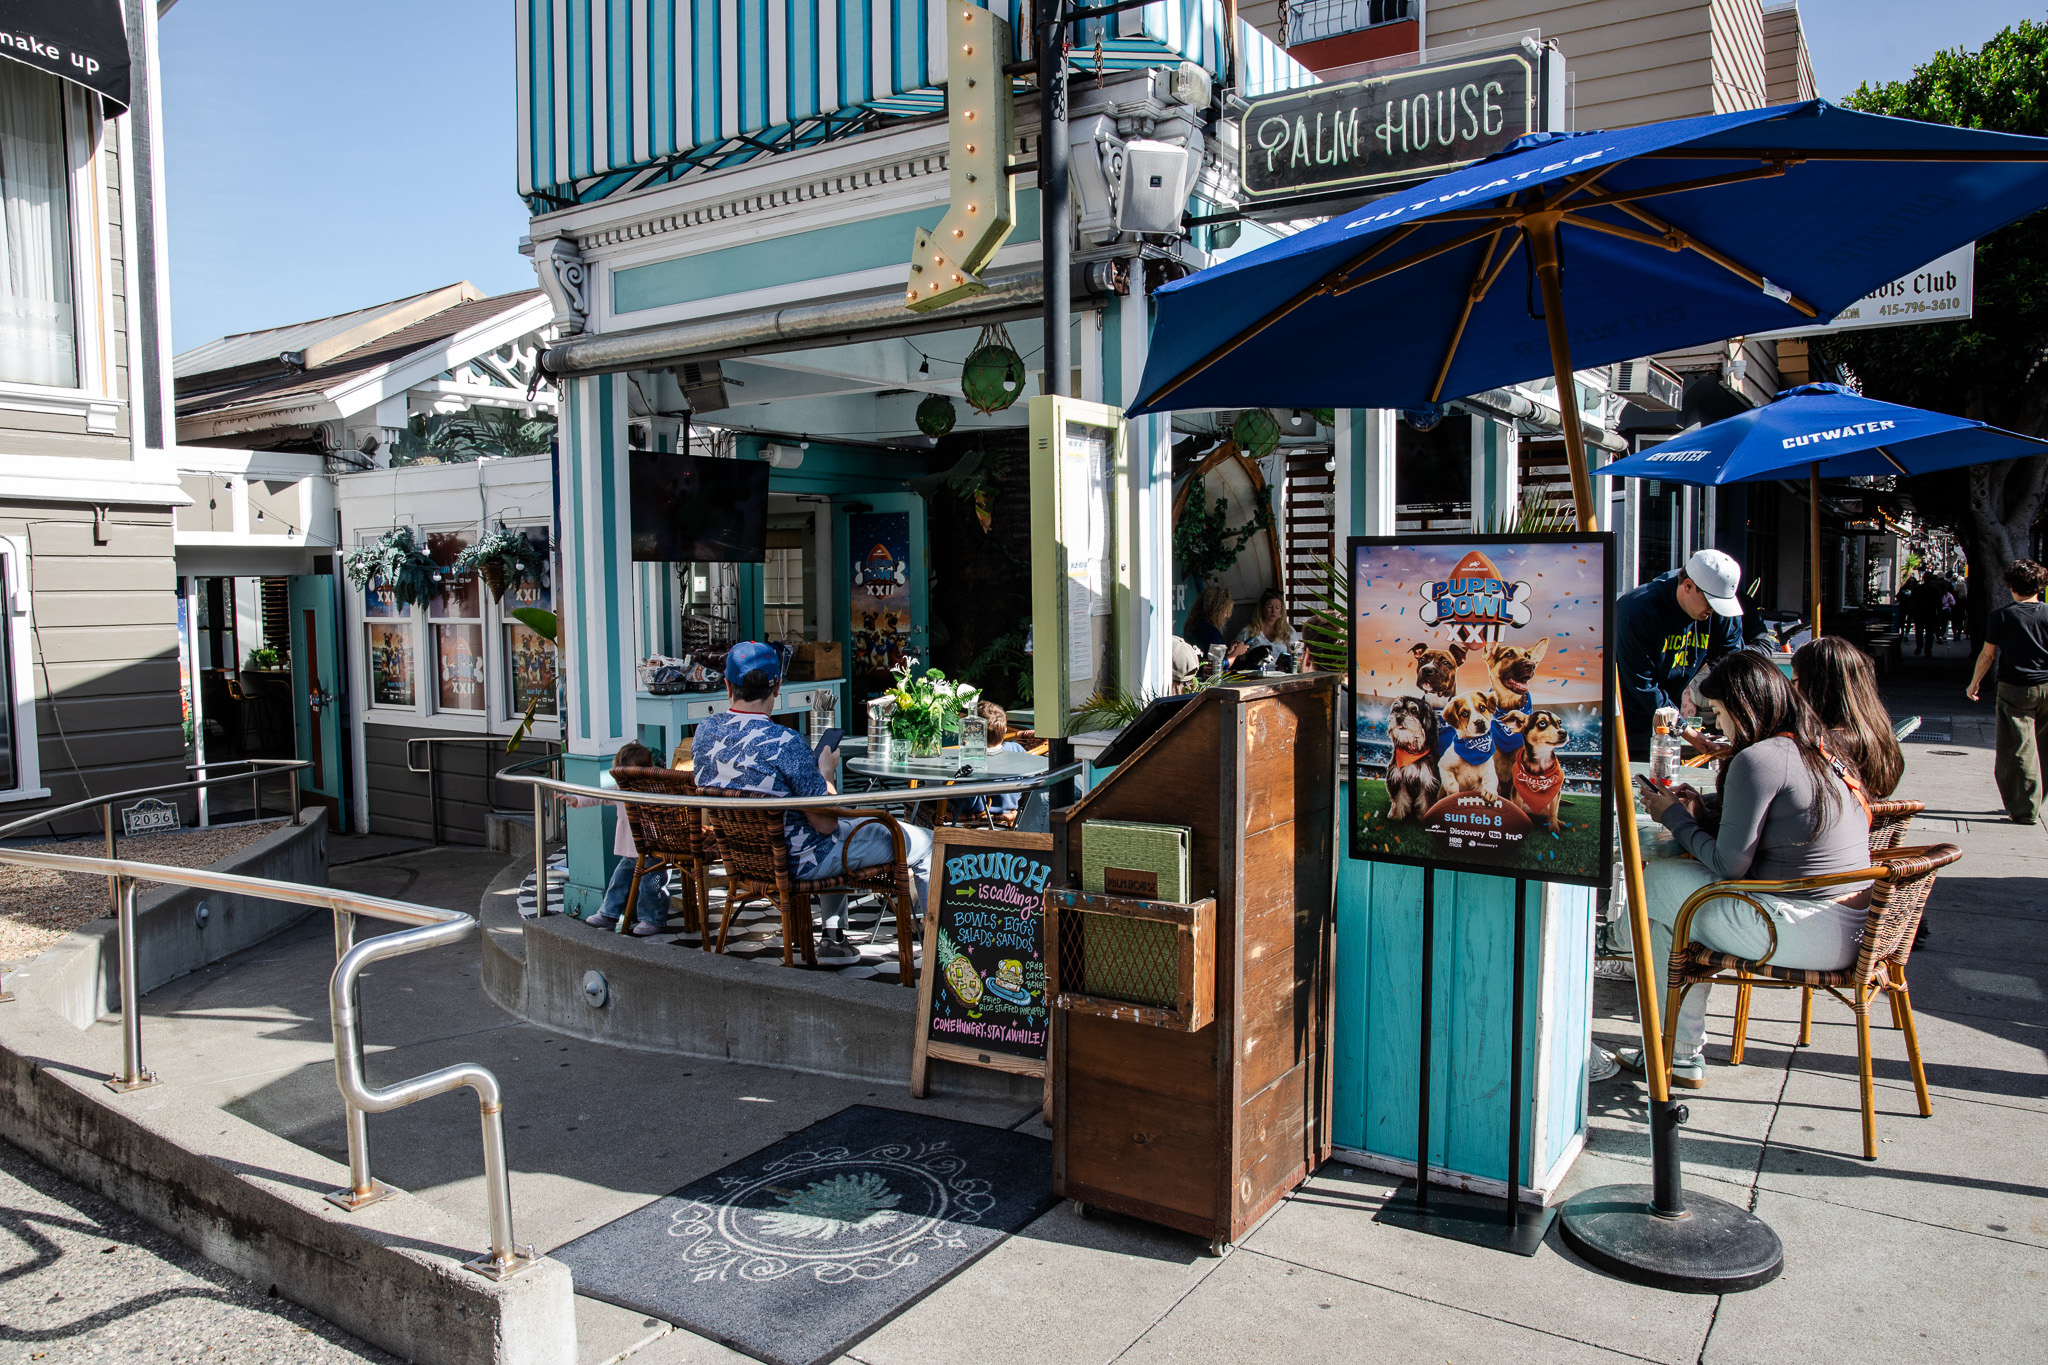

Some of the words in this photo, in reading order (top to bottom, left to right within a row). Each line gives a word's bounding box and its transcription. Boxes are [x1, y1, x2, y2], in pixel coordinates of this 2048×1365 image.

[71, 52, 100, 75] up
[1257, 107, 1360, 172] PALM
[1375, 81, 1504, 156] HOUSE
[1344, 149, 1604, 230] CUTWATER
[1914, 271, 1957, 294] Club
[1879, 298, 1960, 316] 415-796-3610
[1782, 420, 1896, 449] CUTWATER
[1645, 450, 1708, 462] CUTWATER
[866, 585, 895, 596] XXII
[1432, 577, 1519, 602] PUPPY
[1437, 596, 1514, 623] BOWL
[1445, 624, 1506, 643] XXII
[452, 682, 475, 694] XXII
[133, 812, 170, 827] 2036
[1444, 813, 1467, 823] sun
[1470, 813, 1491, 826] feb
[1493, 815, 1503, 827] 8
[1449, 827, 1485, 838] Discovery
[1489, 831, 1501, 839] tbs
[945, 852, 1051, 893] BRUNCH
[954, 912, 997, 929] BOWLS
[1003, 916, 1037, 936] EGGS
[957, 927, 993, 947] SALADS
[996, 932, 1034, 952] SANDOS
[933, 1017, 956, 1032] COME
[956, 1019, 987, 1037] HUNGRY,
[987, 1025, 1007, 1040] STAY
